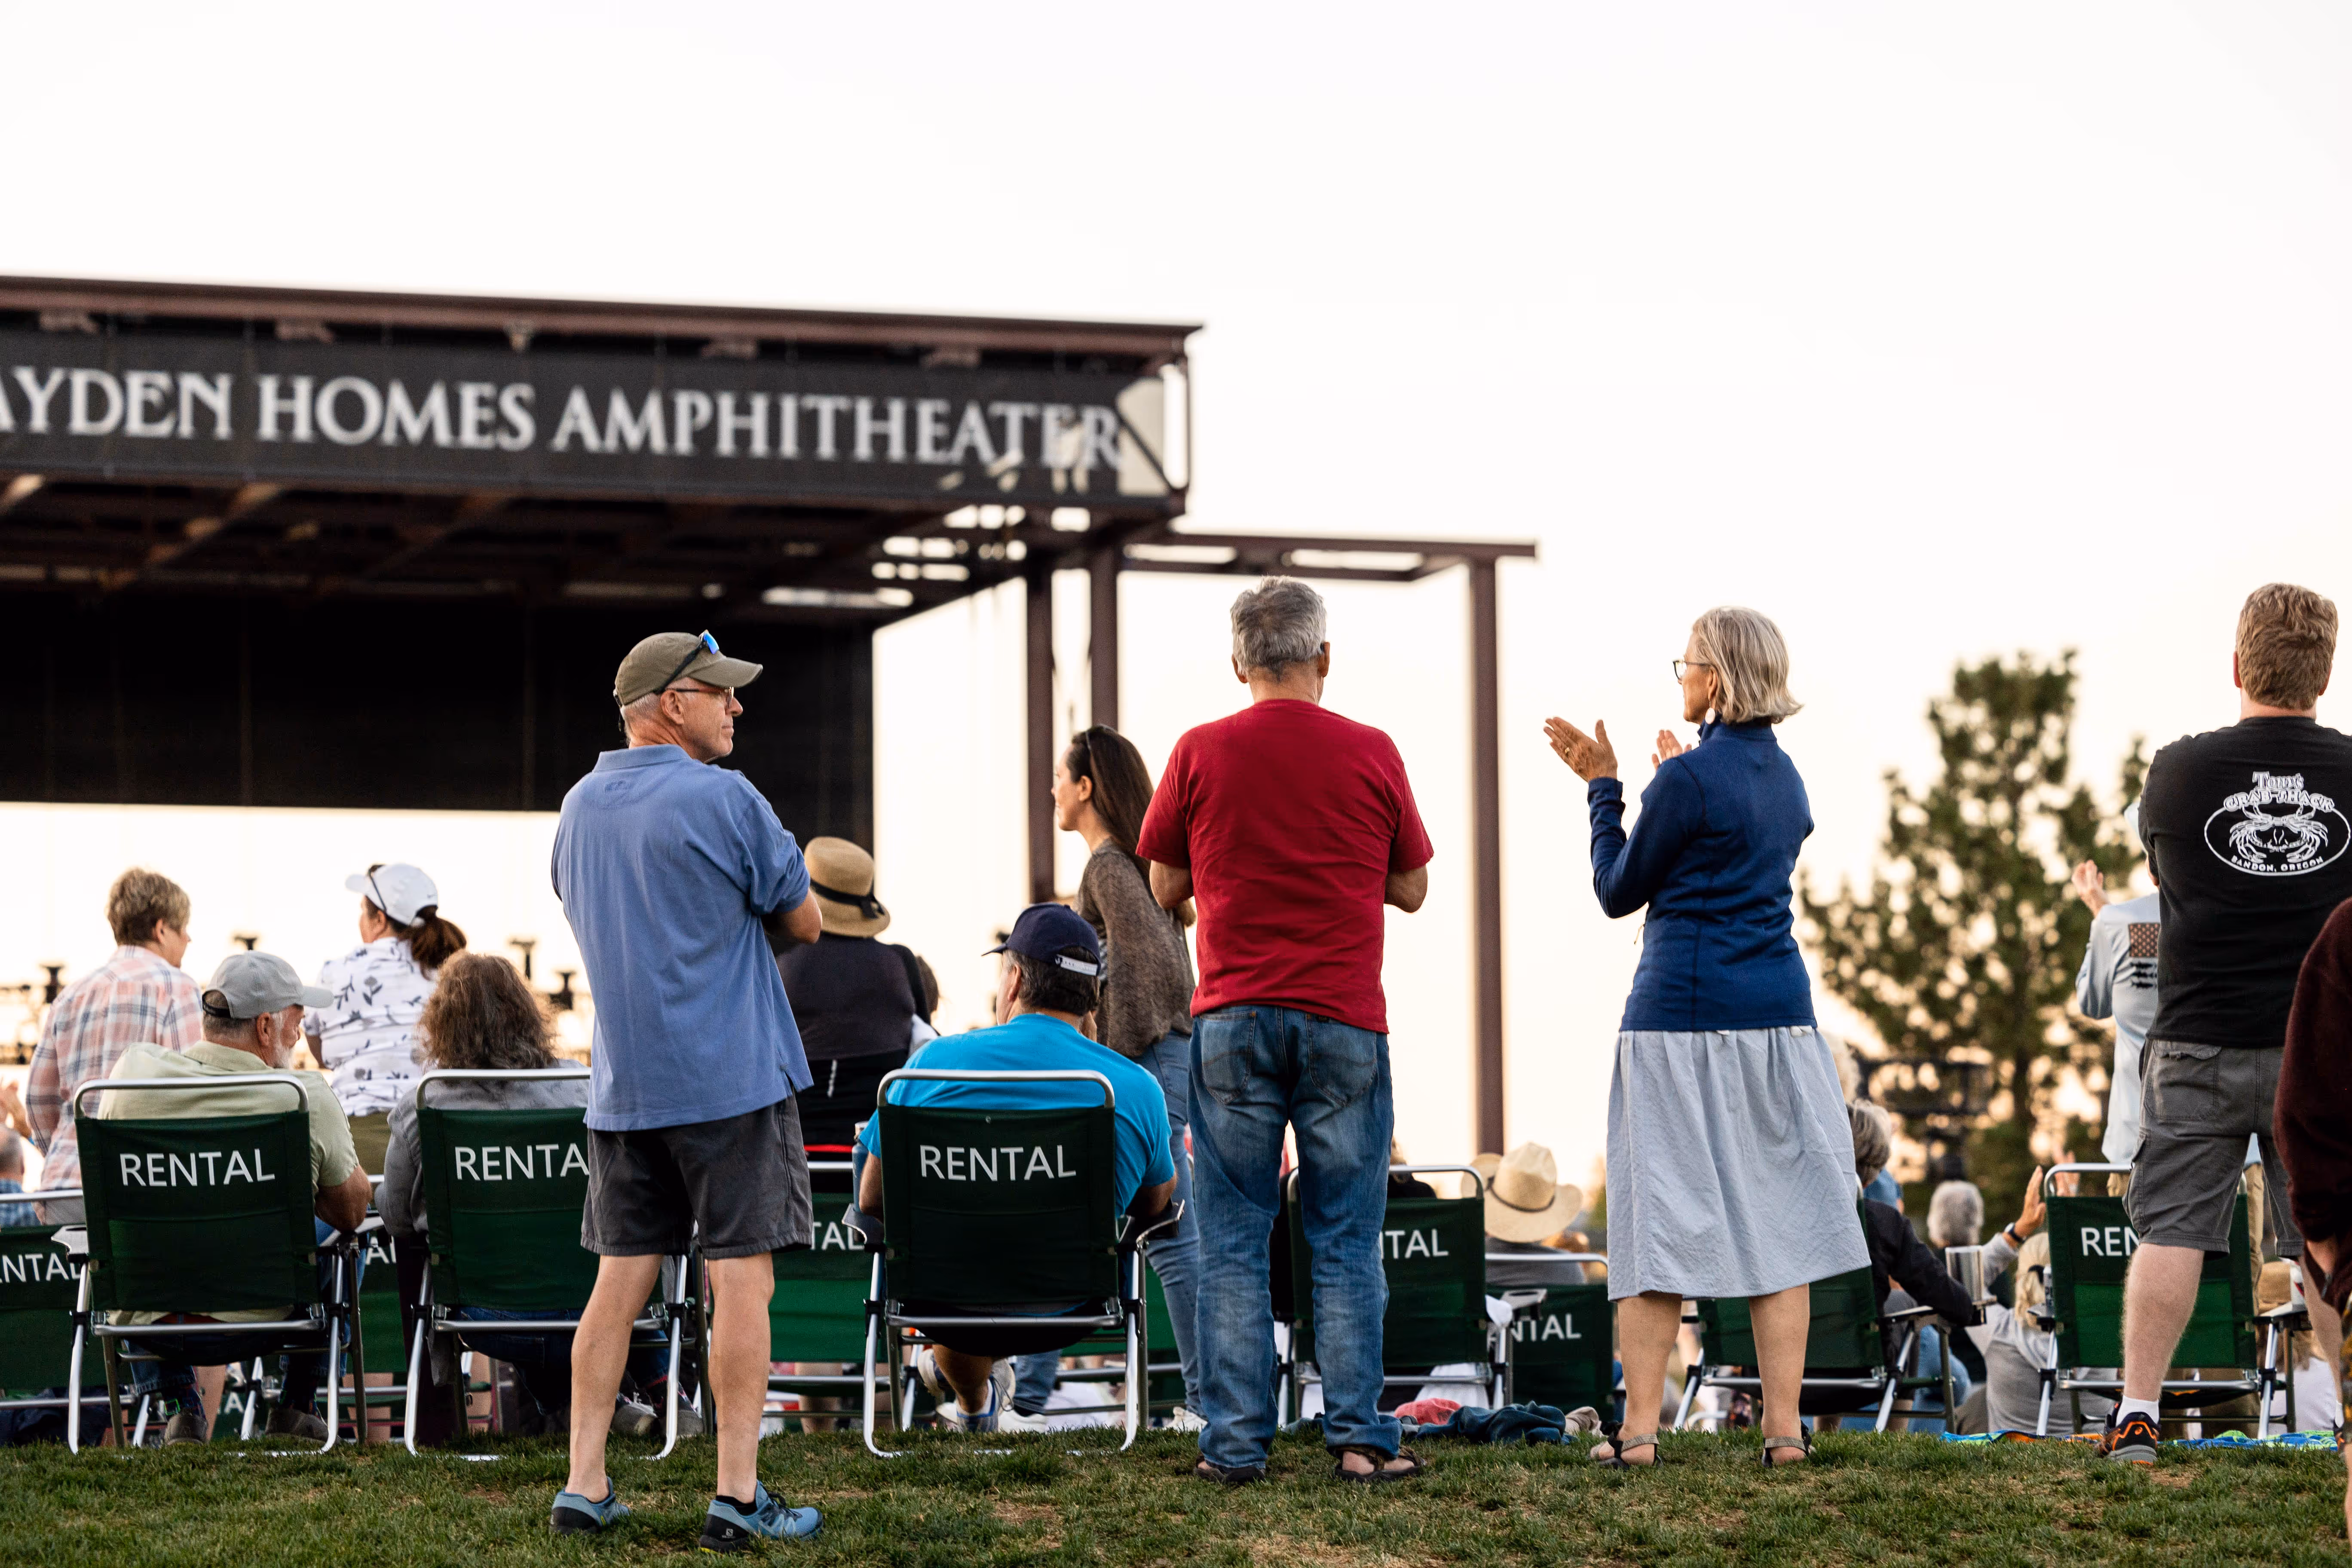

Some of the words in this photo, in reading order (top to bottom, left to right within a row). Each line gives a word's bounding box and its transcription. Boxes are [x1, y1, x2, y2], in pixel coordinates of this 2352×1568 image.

[0, 365, 234, 440] YDEN
[257, 373, 536, 452] HOMES
[551, 386, 1123, 470] AMPHITHEATER
[2252, 772, 2304, 792] Tony's
[2281, 856, 2324, 871] OREGON
[119, 1148, 276, 1187] RENTAL
[455, 1142, 590, 1181] RENTA
[920, 1145, 1076, 1181] RENTAL
[811, 1221, 864, 1250] TAL
[1379, 1228, 1449, 1259] TAL
[2081, 1226, 2139, 1256] REN
[0, 1253, 81, 1284] NTAL
